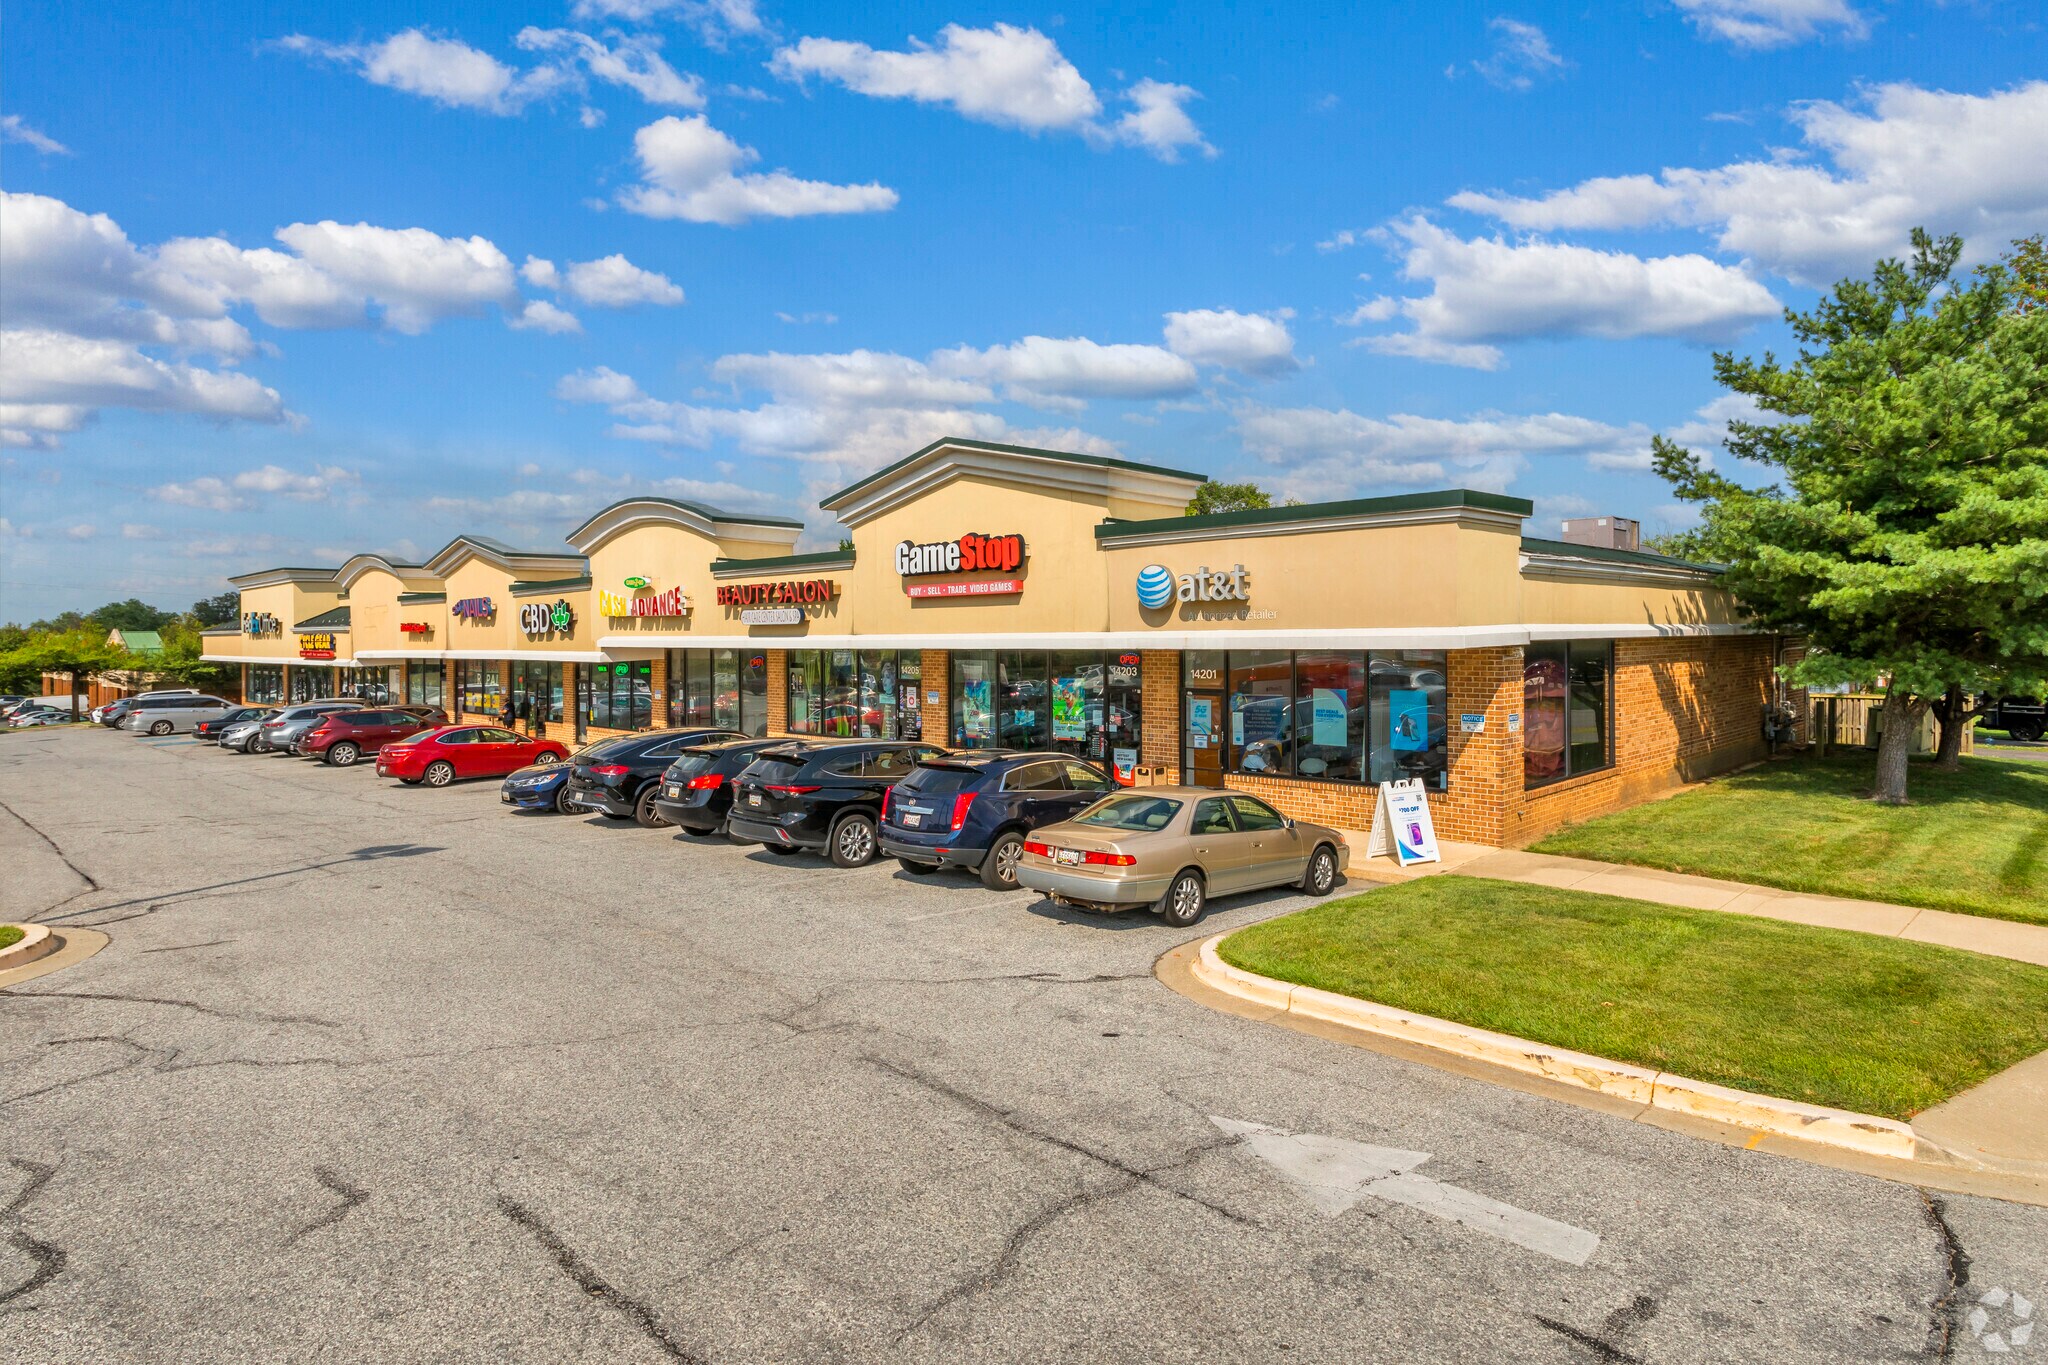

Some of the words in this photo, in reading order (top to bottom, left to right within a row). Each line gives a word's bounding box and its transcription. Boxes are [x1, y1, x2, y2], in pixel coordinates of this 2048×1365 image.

[896, 535, 1020, 575] GameStop
[910, 587, 922, 596] BUY
[927, 585, 941, 595] SELL
[947, 584, 967, 594] TRADE
[969, 583, 989, 593] VIDEO
[989, 582, 1013, 592] GAMES
[1177, 564, 1246, 602] at&t
[600, 590, 627, 616] CASH
[631, 586, 681, 616] ADVANCE
[717, 585, 773, 605] BEAUTY
[777, 581, 829, 603] SALON
[463, 598, 488, 617] NAILS
[1188, 610, 1238, 621] Authorized
[1241, 608, 1278, 620] Retailer
[520, 604, 549, 634] CBD
[1121, 656, 1139, 665] OPEN
[901, 666, 919, 674] 14205
[1113, 667, 1137, 676] 14203
[1191, 670, 1216, 679] 14201
